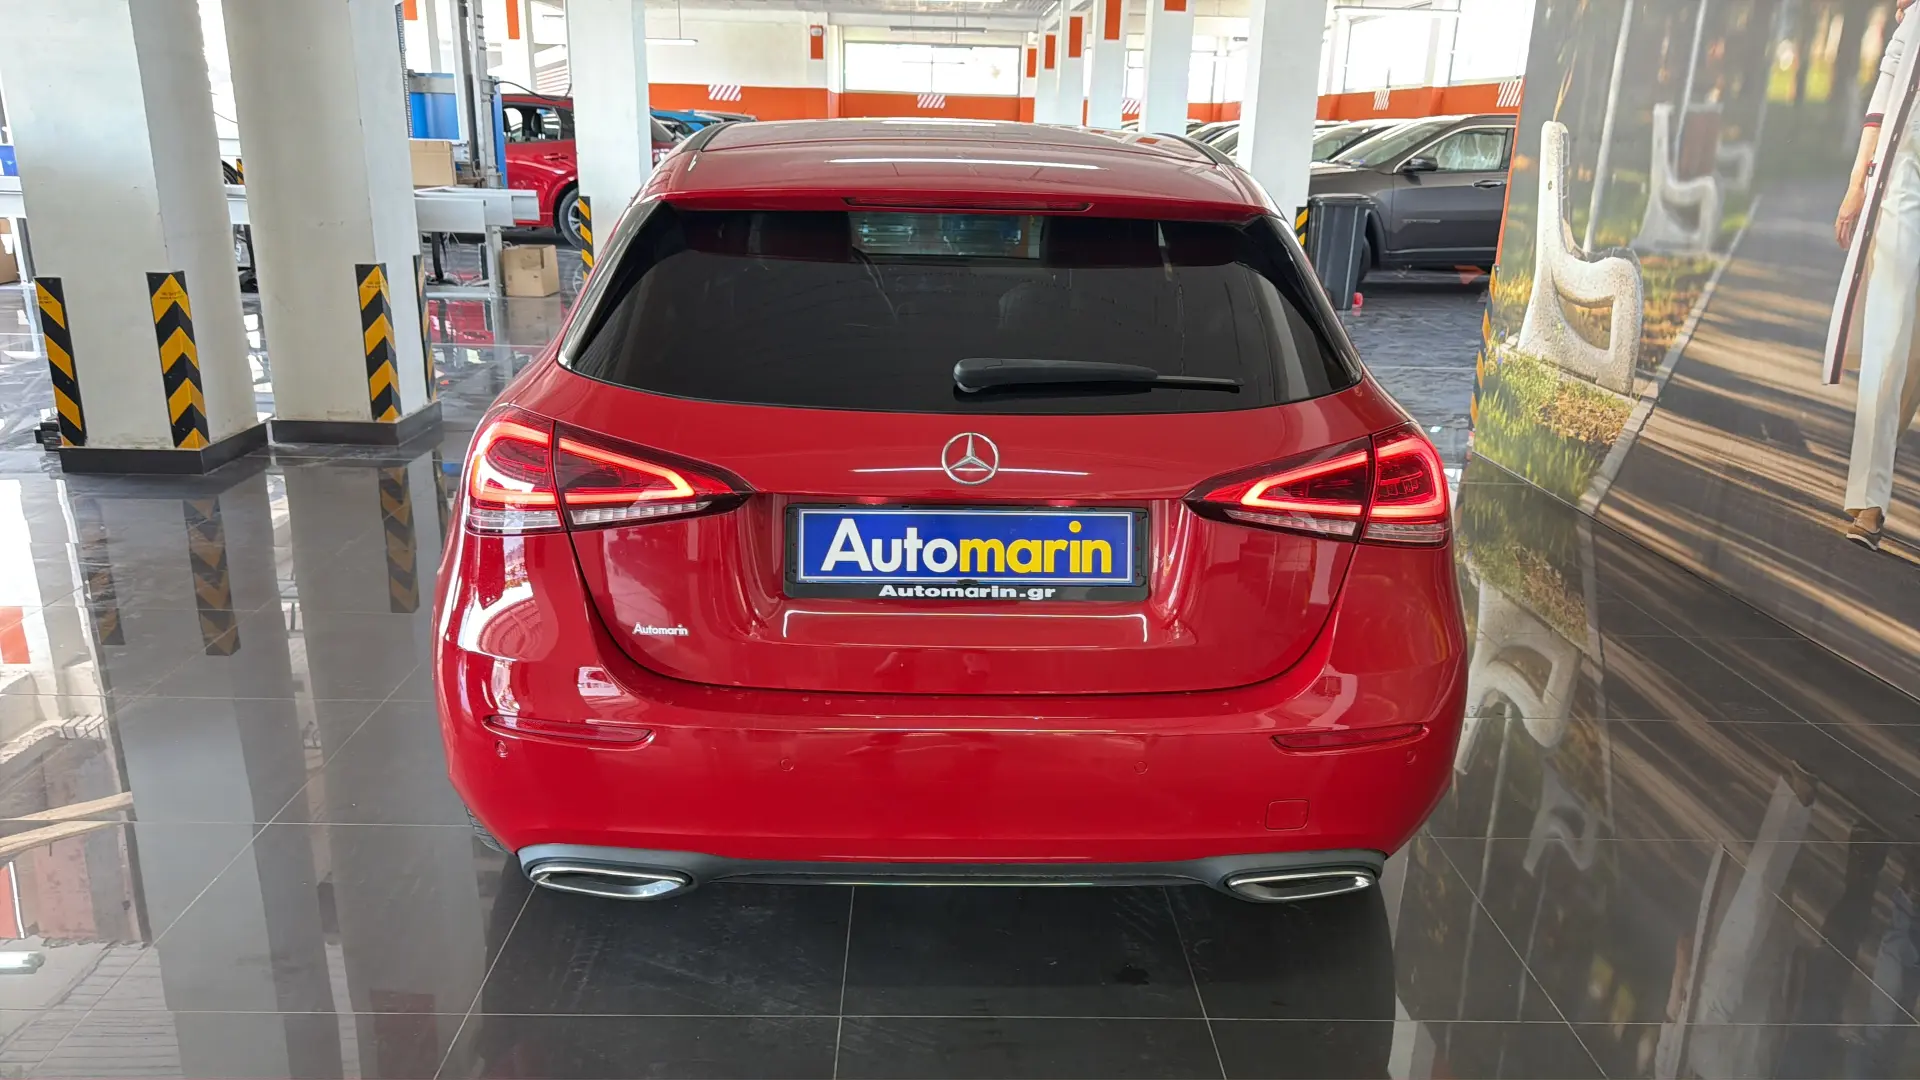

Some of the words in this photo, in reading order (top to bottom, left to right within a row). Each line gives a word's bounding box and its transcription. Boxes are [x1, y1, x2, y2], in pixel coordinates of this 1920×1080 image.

[820, 518, 1112, 574] Automarin
[878, 584, 1056, 601] Automarin.gr
[632, 622, 689, 636] Automarin
